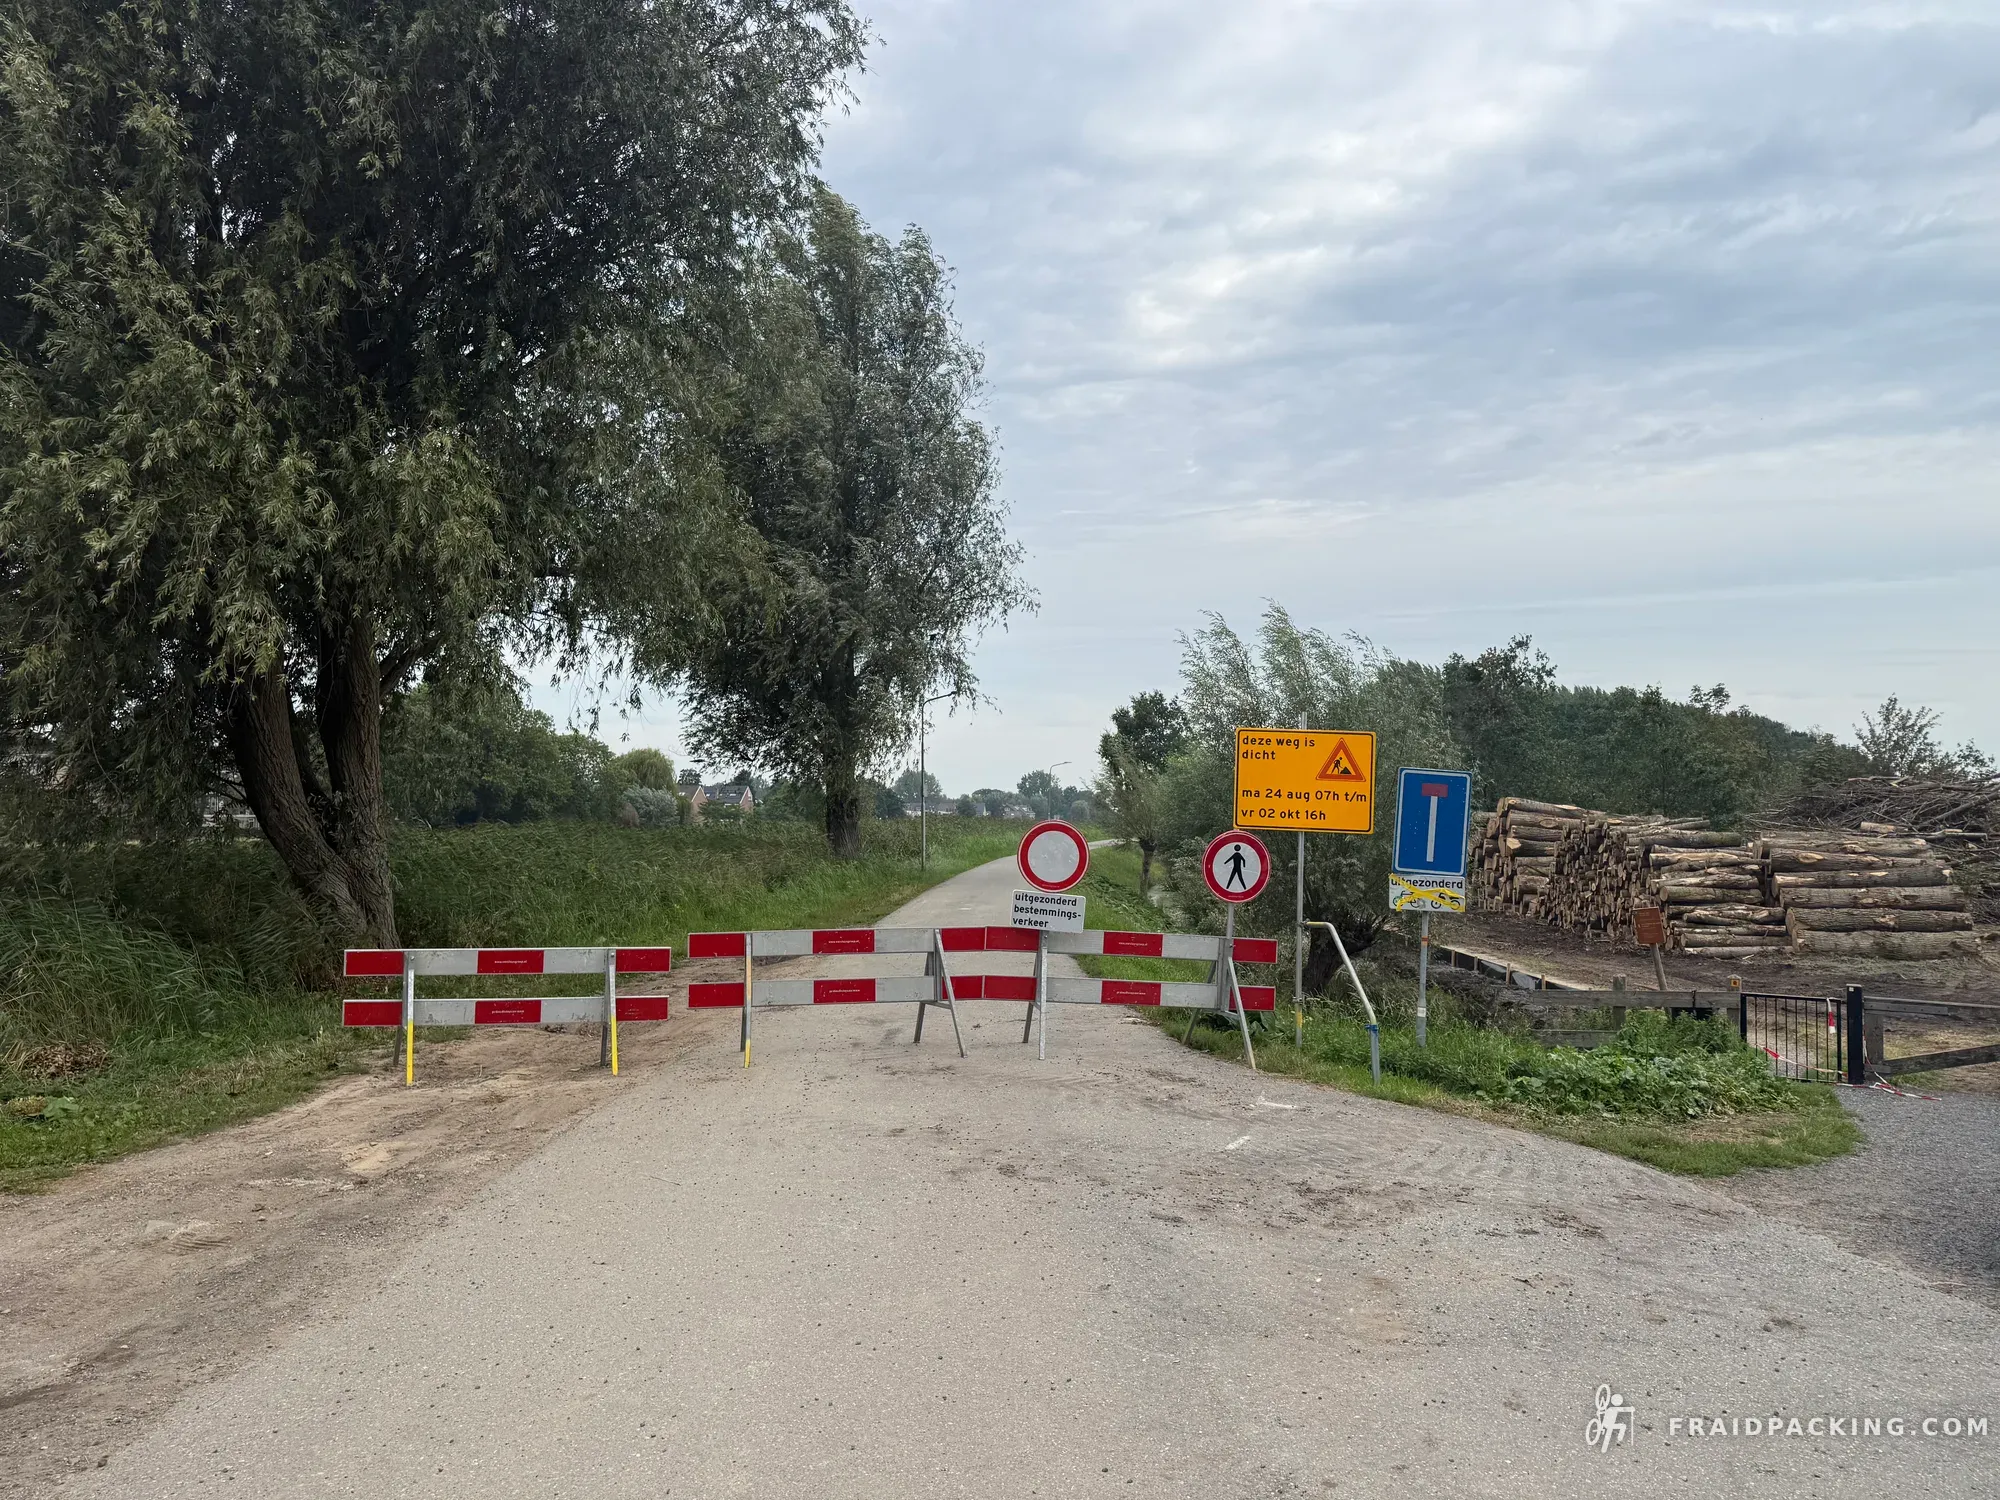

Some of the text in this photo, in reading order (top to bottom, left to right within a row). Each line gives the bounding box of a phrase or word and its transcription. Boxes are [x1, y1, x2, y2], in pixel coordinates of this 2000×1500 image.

[1242, 735, 1315, 749] deze weg is
[1242, 750, 1276, 760] dicht
[1242, 788, 1367, 803] ma 24 aug 07h t/m
[1241, 808, 1326, 820] vr 02 okt 16h
[1015, 892, 1077, 907] uitgezonderd
[1014, 904, 1081, 920] bestemmings-
[1012, 917, 1049, 928] verkeer
